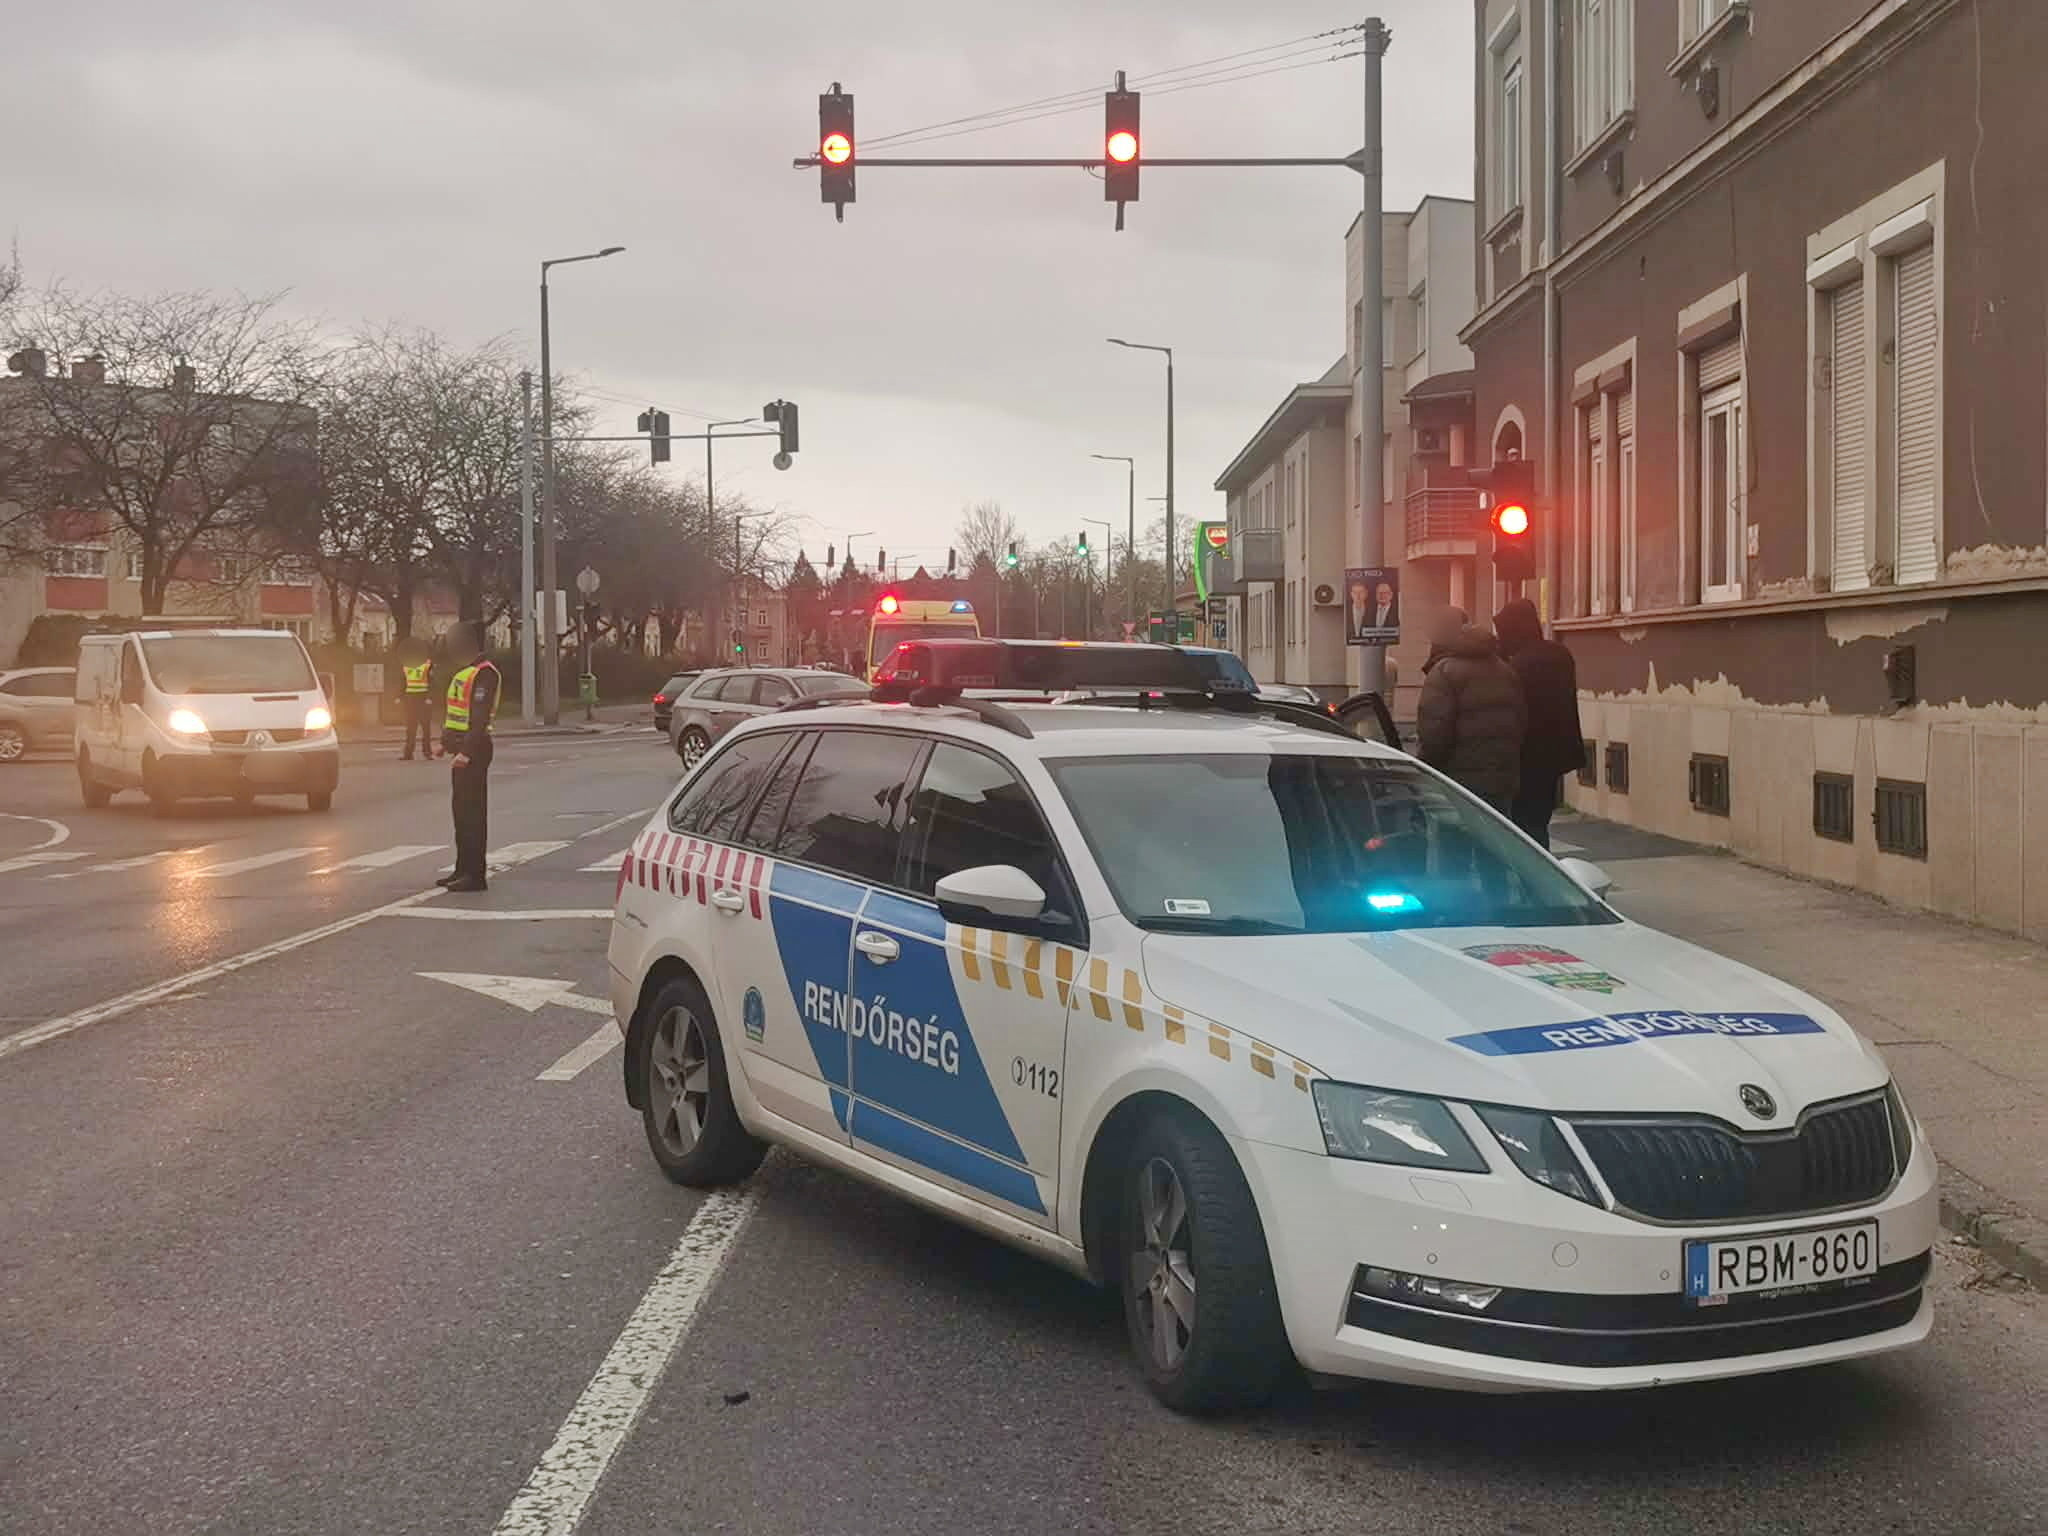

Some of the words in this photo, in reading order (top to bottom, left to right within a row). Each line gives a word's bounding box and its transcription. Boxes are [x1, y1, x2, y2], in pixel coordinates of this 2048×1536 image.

[804, 980, 960, 1075] RENDŐRSÉG
[1541, 1010, 1778, 1048] RENDŐRSÉG
[1028, 1062, 1059, 1098] 112
[1718, 1230, 1869, 1289] RBM-860
[1693, 1273, 1704, 1290] H
